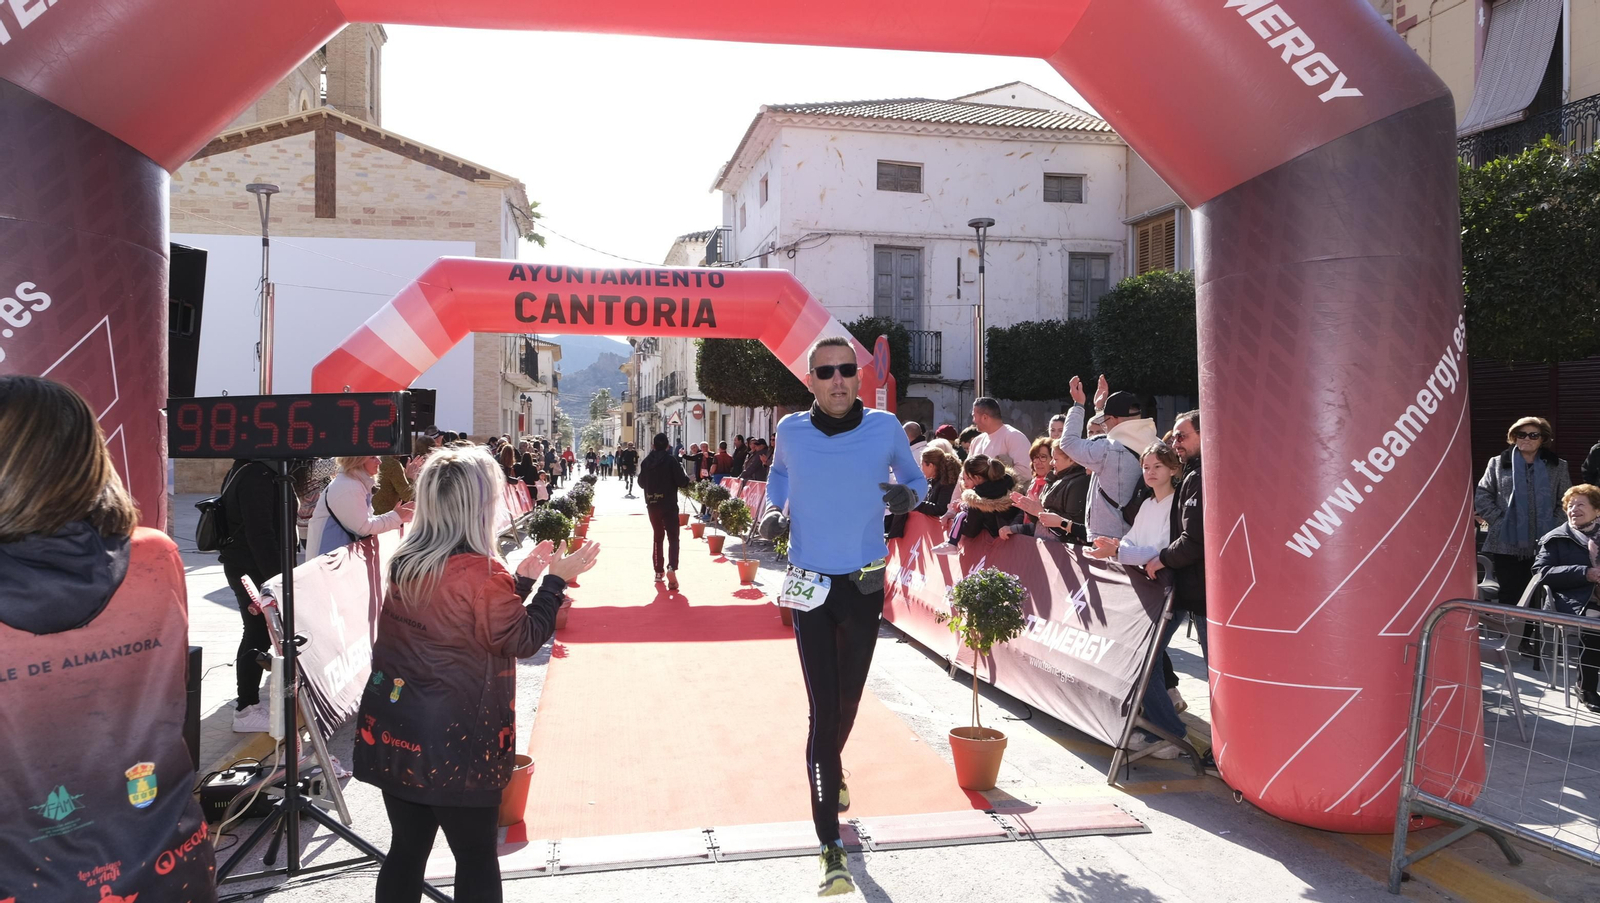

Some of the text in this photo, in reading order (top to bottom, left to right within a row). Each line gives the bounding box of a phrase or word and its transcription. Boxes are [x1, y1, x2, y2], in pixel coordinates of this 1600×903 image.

[508, 264, 725, 288] AYUNTAMIENTO
[514, 291, 717, 328] CANTORIA
[1285, 314, 1466, 558] www.teamergy.es
[785, 579, 815, 600] 254
[28, 661, 52, 677] DE
[62, 637, 162, 670] ALMANZORA
[1021, 613, 1116, 665] TEAMERGY
